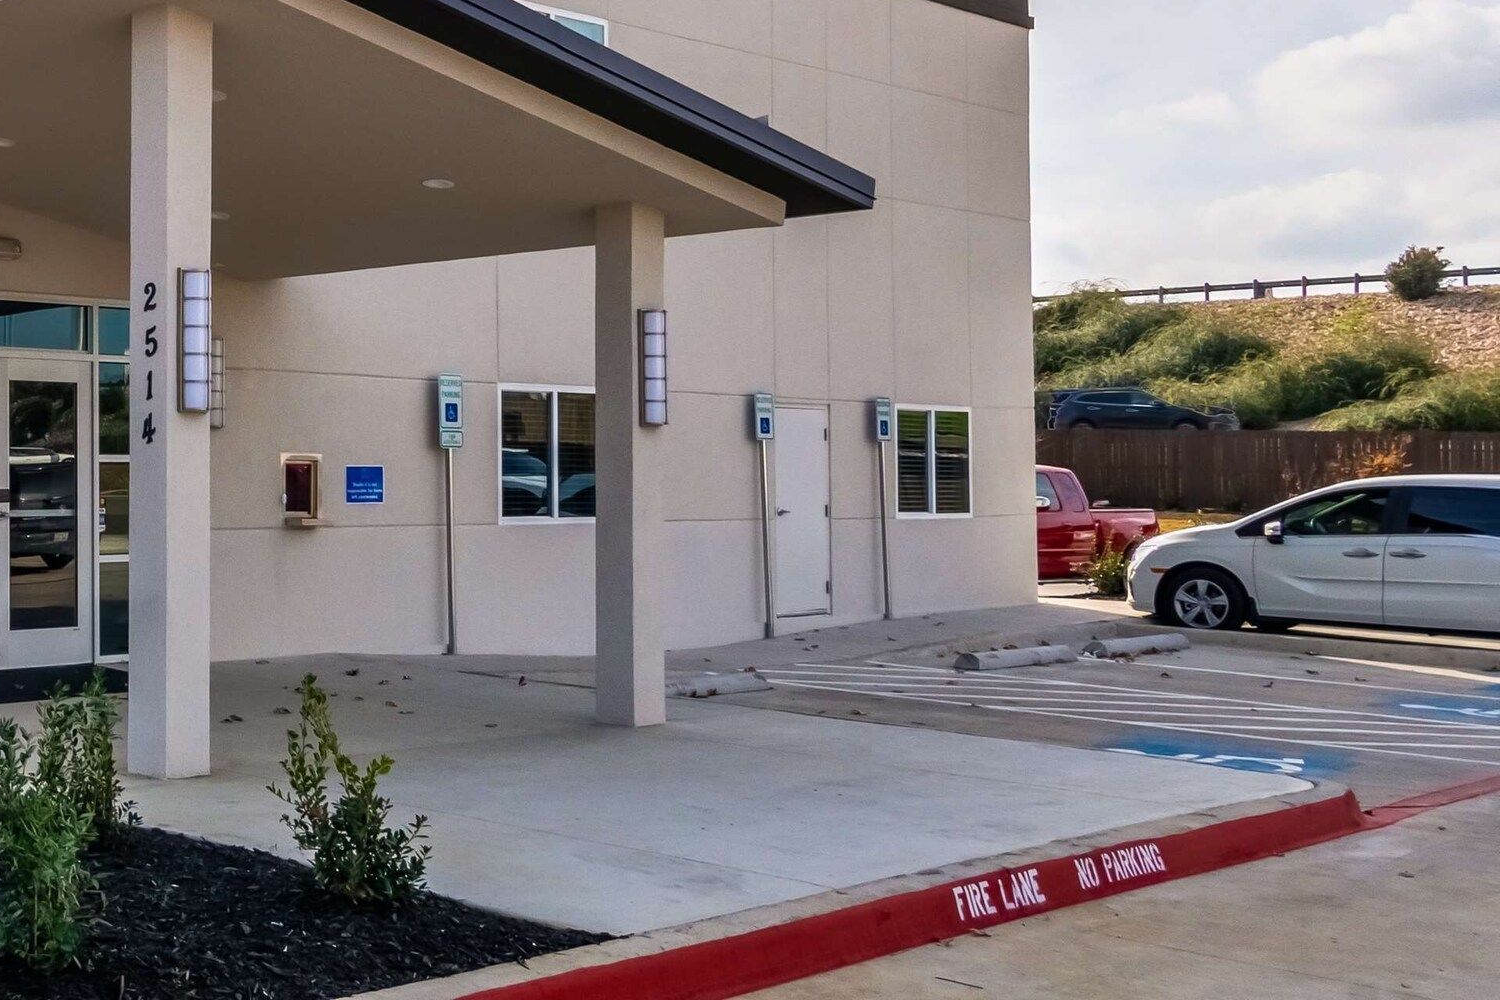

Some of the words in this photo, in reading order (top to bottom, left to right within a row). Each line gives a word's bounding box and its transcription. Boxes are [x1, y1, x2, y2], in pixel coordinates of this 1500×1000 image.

[952, 880, 997, 921] FIRE
[998, 868, 1046, 910] LANE
[1074, 857, 1100, 890] NO
[1100, 842, 1167, 883] PARKING
